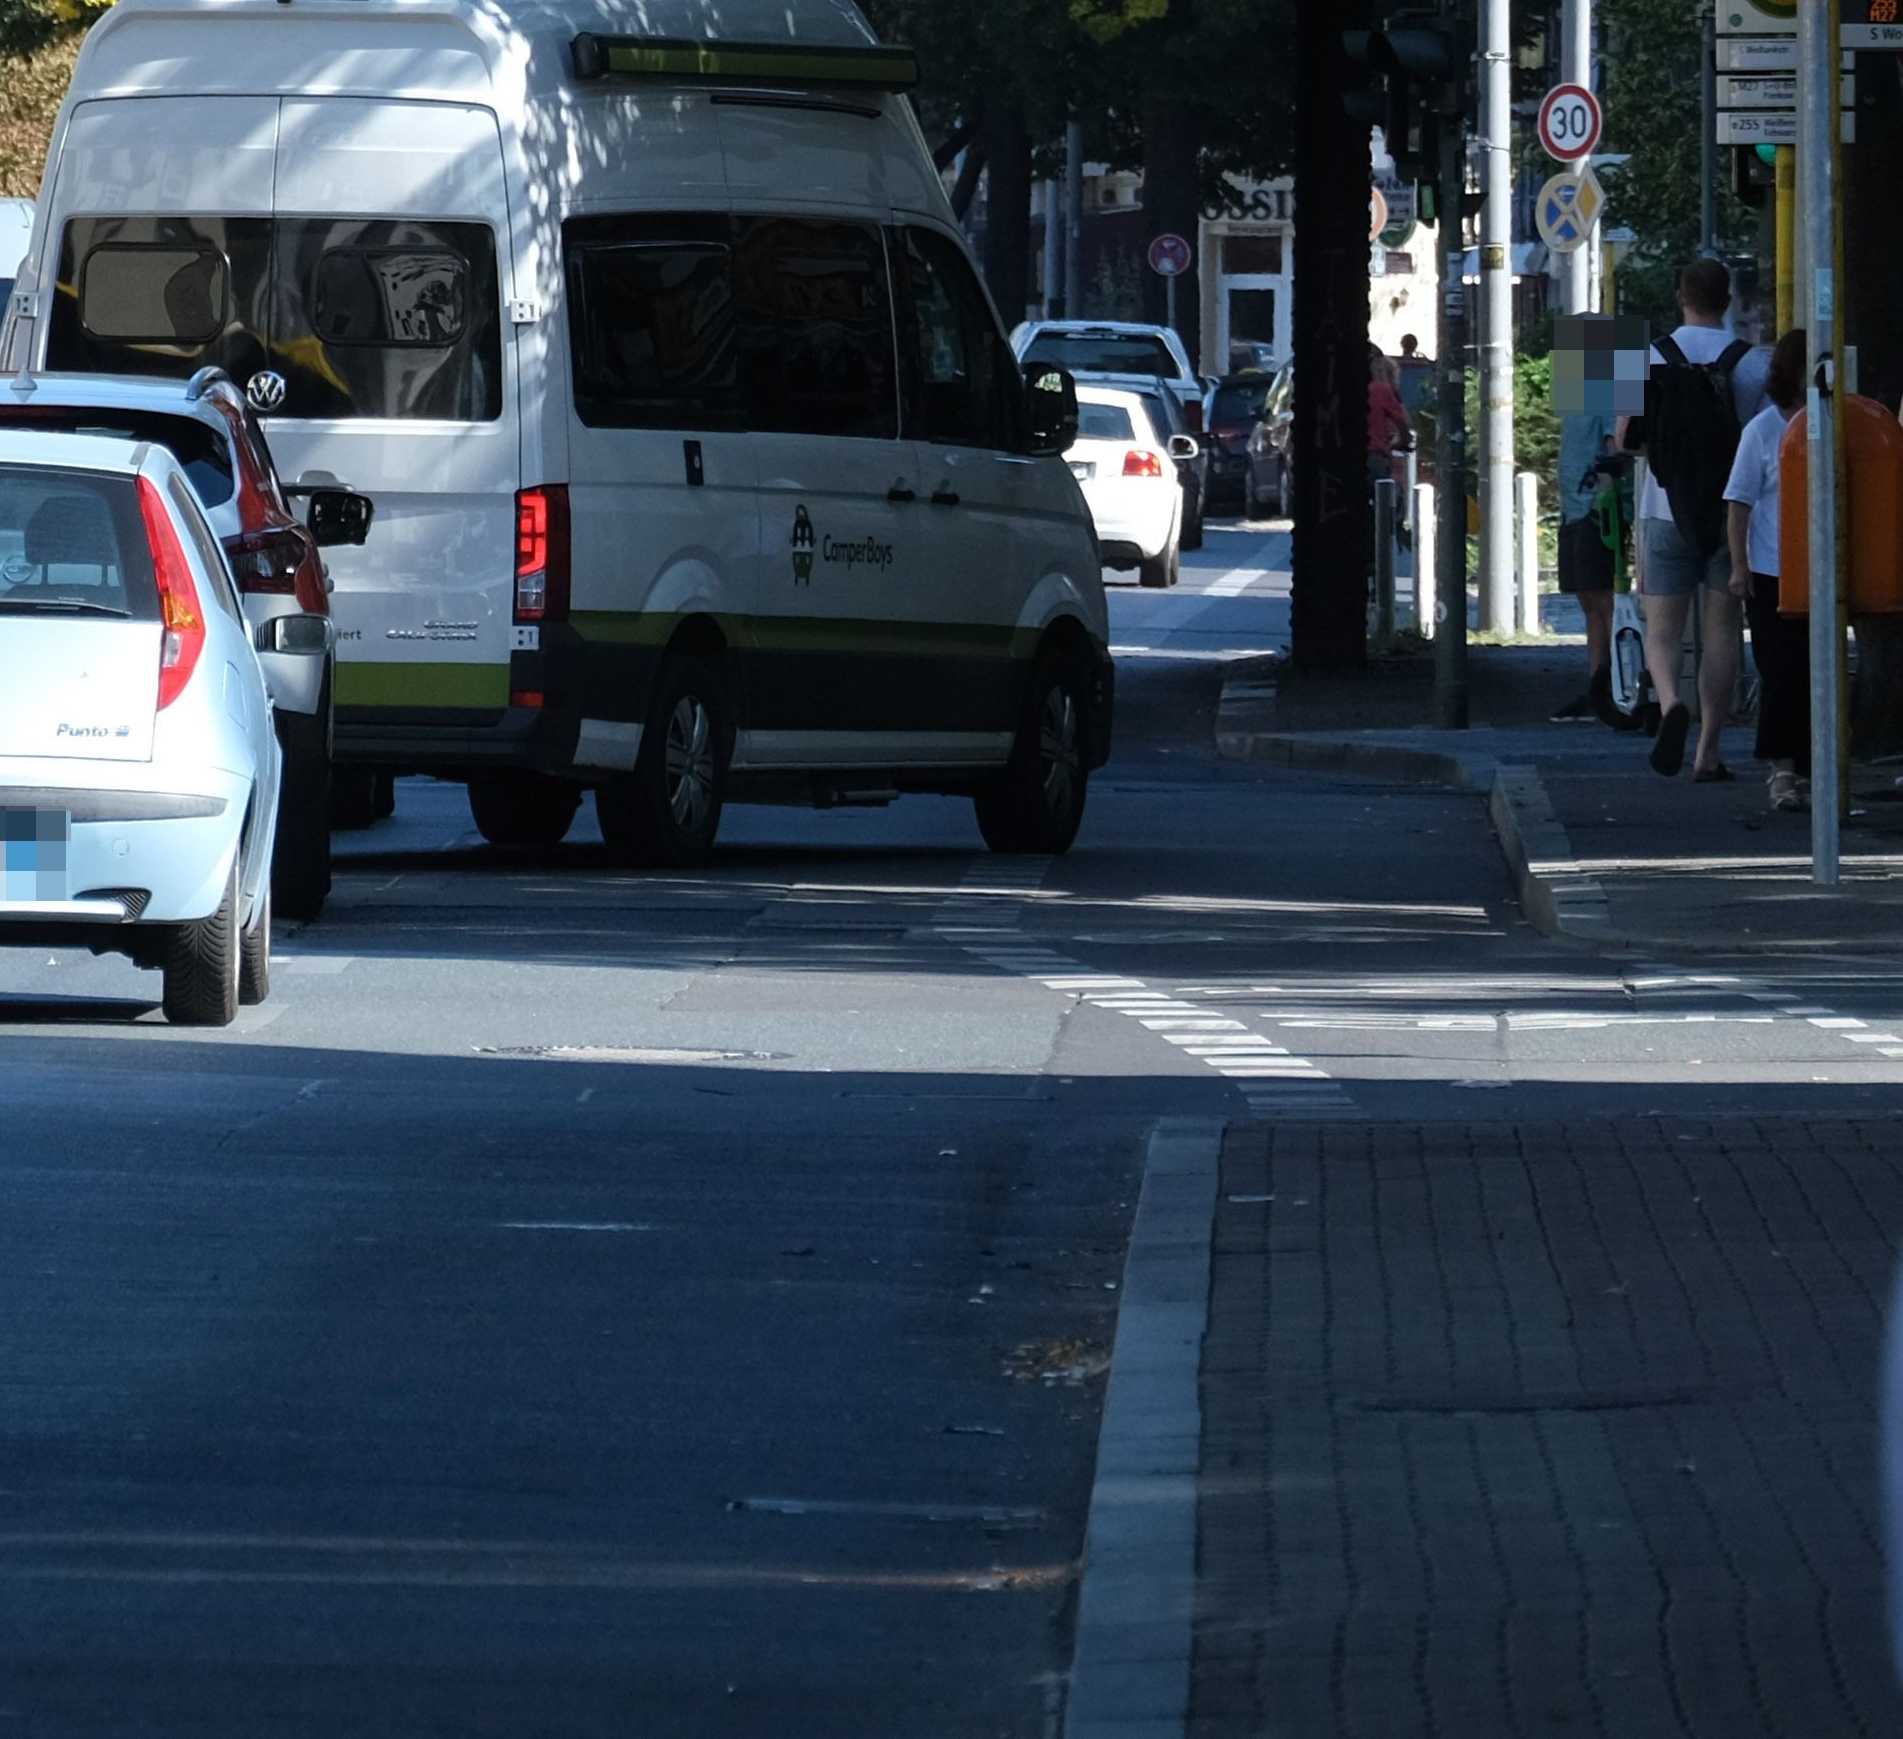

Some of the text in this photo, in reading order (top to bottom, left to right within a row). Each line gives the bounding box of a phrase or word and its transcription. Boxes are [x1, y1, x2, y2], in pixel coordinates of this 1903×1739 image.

[1870, 9, 1897, 22] M27
[1870, 27, 1903, 40] S Wo
[1553, 105, 1587, 140] 30
[1738, 118, 1760, 131] 255
[822, 533, 893, 573] CamperBoys
[56, 722, 110, 738] Punto
